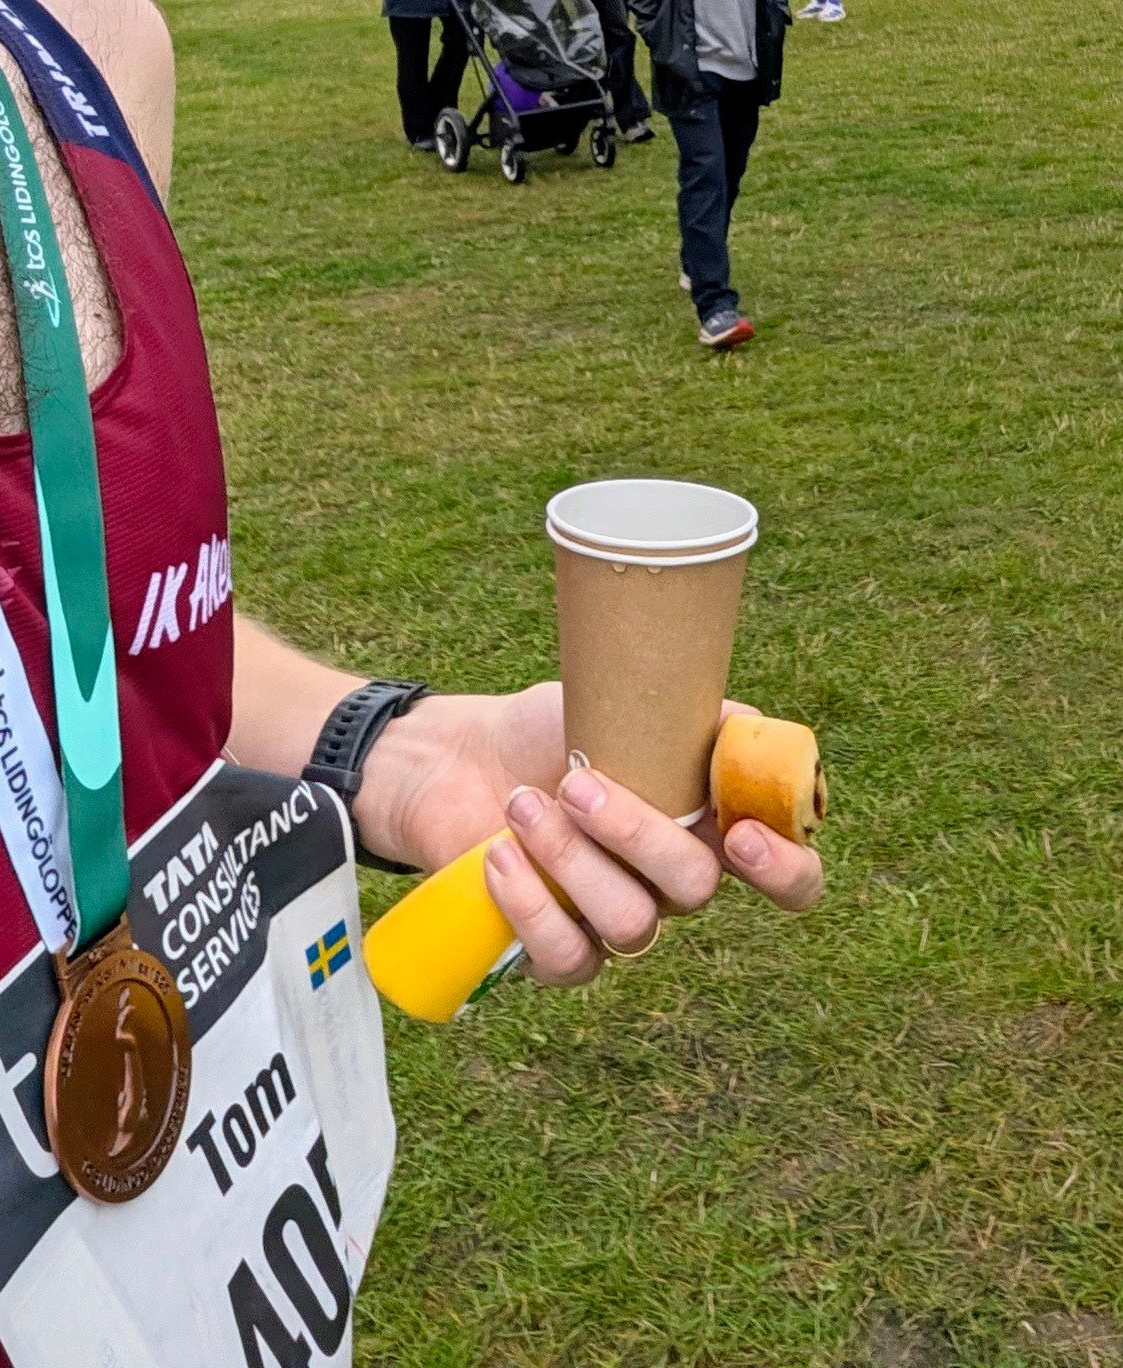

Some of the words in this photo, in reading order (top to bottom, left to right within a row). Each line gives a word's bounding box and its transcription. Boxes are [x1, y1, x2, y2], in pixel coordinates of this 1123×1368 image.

[23, 228, 46, 270] tcs
[129, 561, 189, 656] IK
[0, 745, 78, 941] LIDINGÖLOPPE
[142, 820, 220, 915] TATA
[162, 779, 319, 961] CONSULTANCY
[176, 870, 262, 1010] SERVICES
[185, 1052, 297, 1197] Tom
